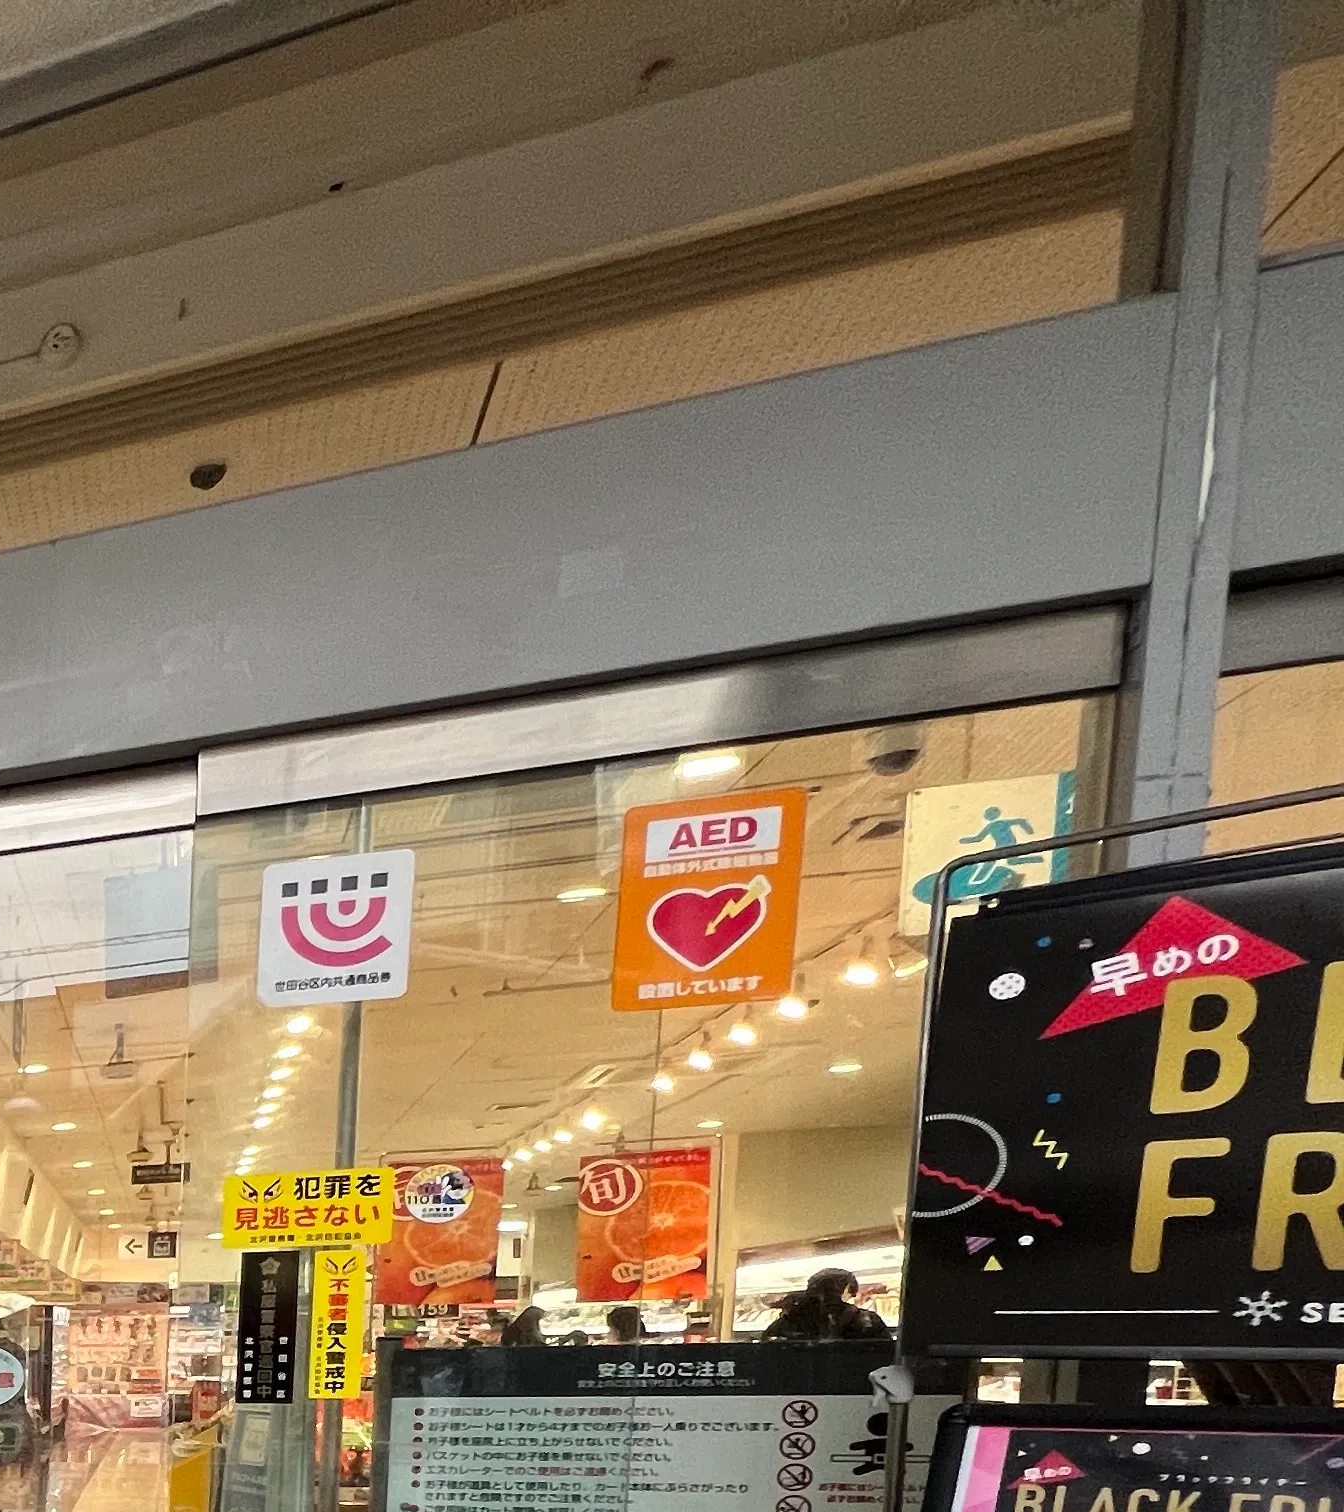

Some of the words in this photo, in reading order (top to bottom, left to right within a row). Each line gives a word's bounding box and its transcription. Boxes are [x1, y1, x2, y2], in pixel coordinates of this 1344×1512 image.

[669, 816, 758, 850] AED
[1090, 933, 1240, 996] 早めの
[293, 1174, 381, 1200] 犯罪を
[582, 1164, 627, 1205] 旬
[234, 1204, 380, 1231] 見逃さない
[1130, 1131, 1344, 1274] FR
[597, 1361, 736, 1378] 安全上のご注意
